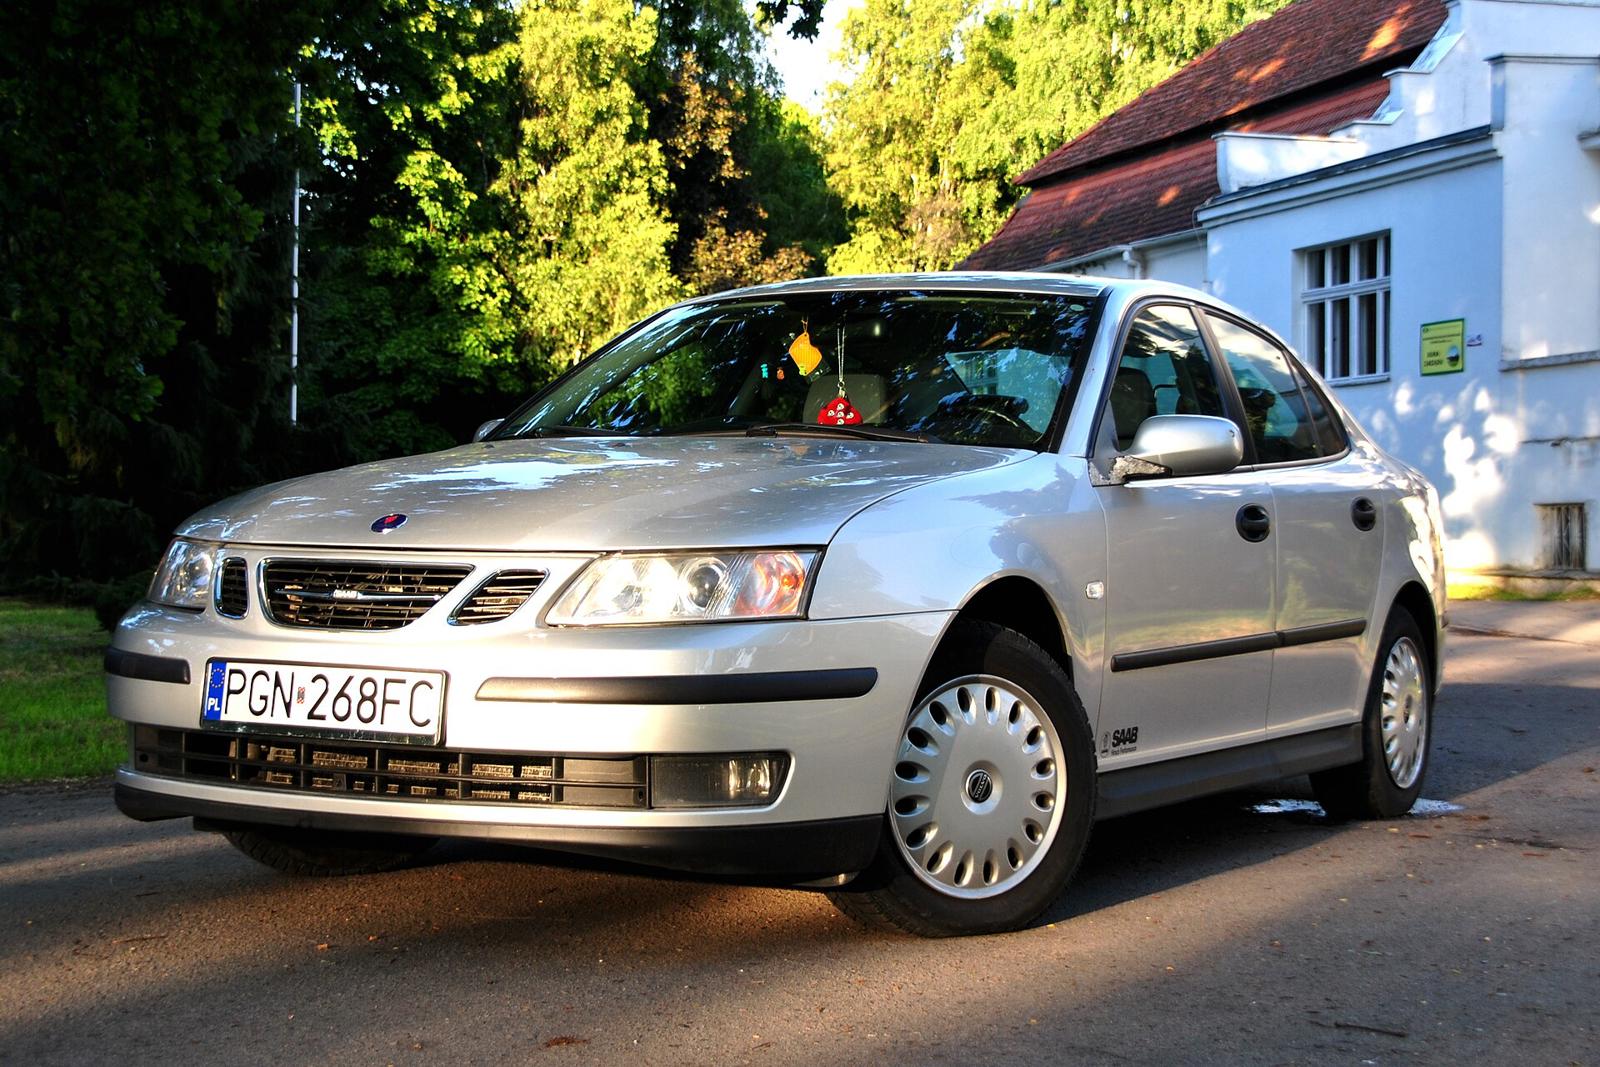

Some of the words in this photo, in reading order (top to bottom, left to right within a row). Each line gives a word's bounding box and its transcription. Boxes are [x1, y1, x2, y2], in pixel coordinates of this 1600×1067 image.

[207, 697, 221, 711] PL
[224, 669, 295, 718] PGN
[307, 673, 434, 728] 268FC
[1111, 726, 1139, 747] SAAB
